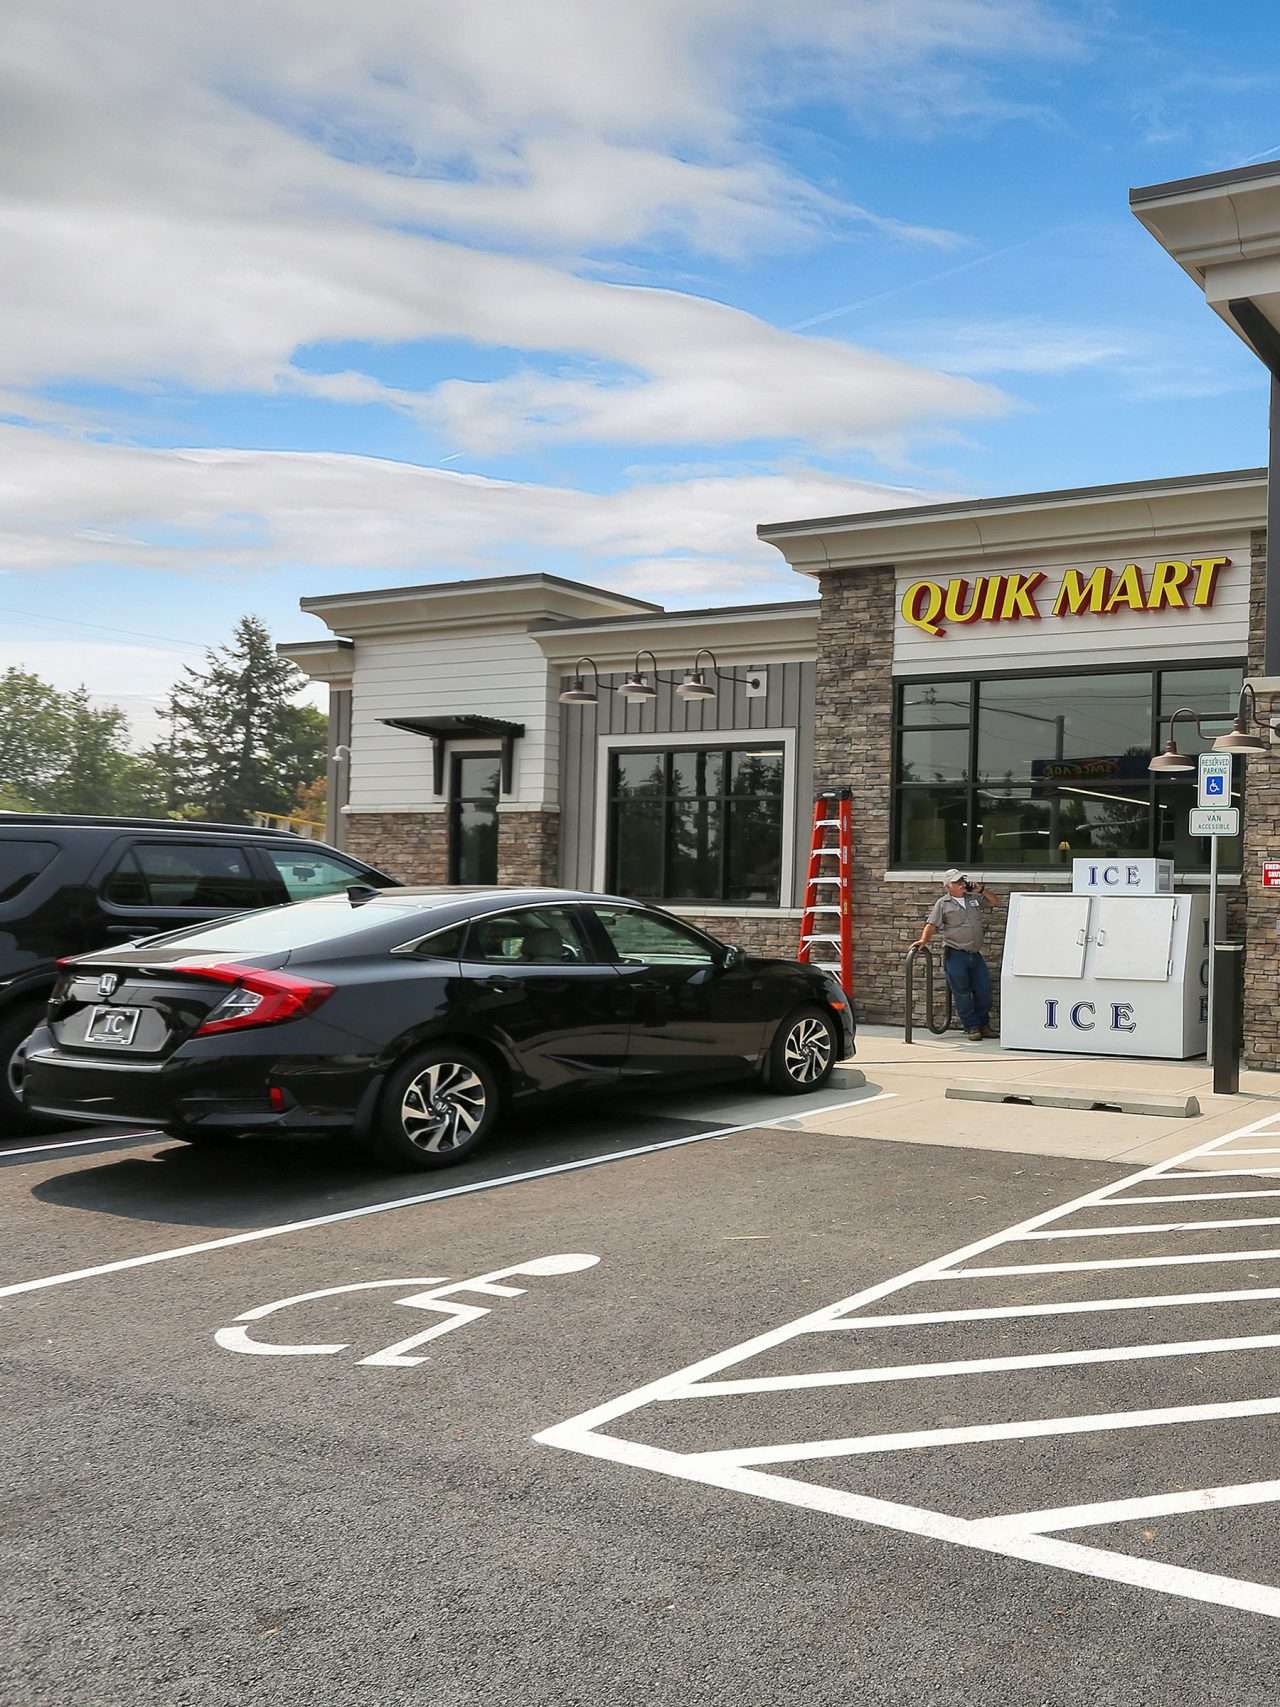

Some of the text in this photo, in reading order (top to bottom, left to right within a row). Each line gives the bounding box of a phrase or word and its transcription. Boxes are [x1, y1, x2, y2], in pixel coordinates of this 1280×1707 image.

[901, 556, 1232, 637] QUIK MART
[1201, 758, 1229, 767] RESERVED
[1203, 767, 1228, 775] PARKING
[1087, 865, 1142, 887] ICE
[105, 1015, 125, 1032] TC
[1044, 999, 1137, 1033] ICE
